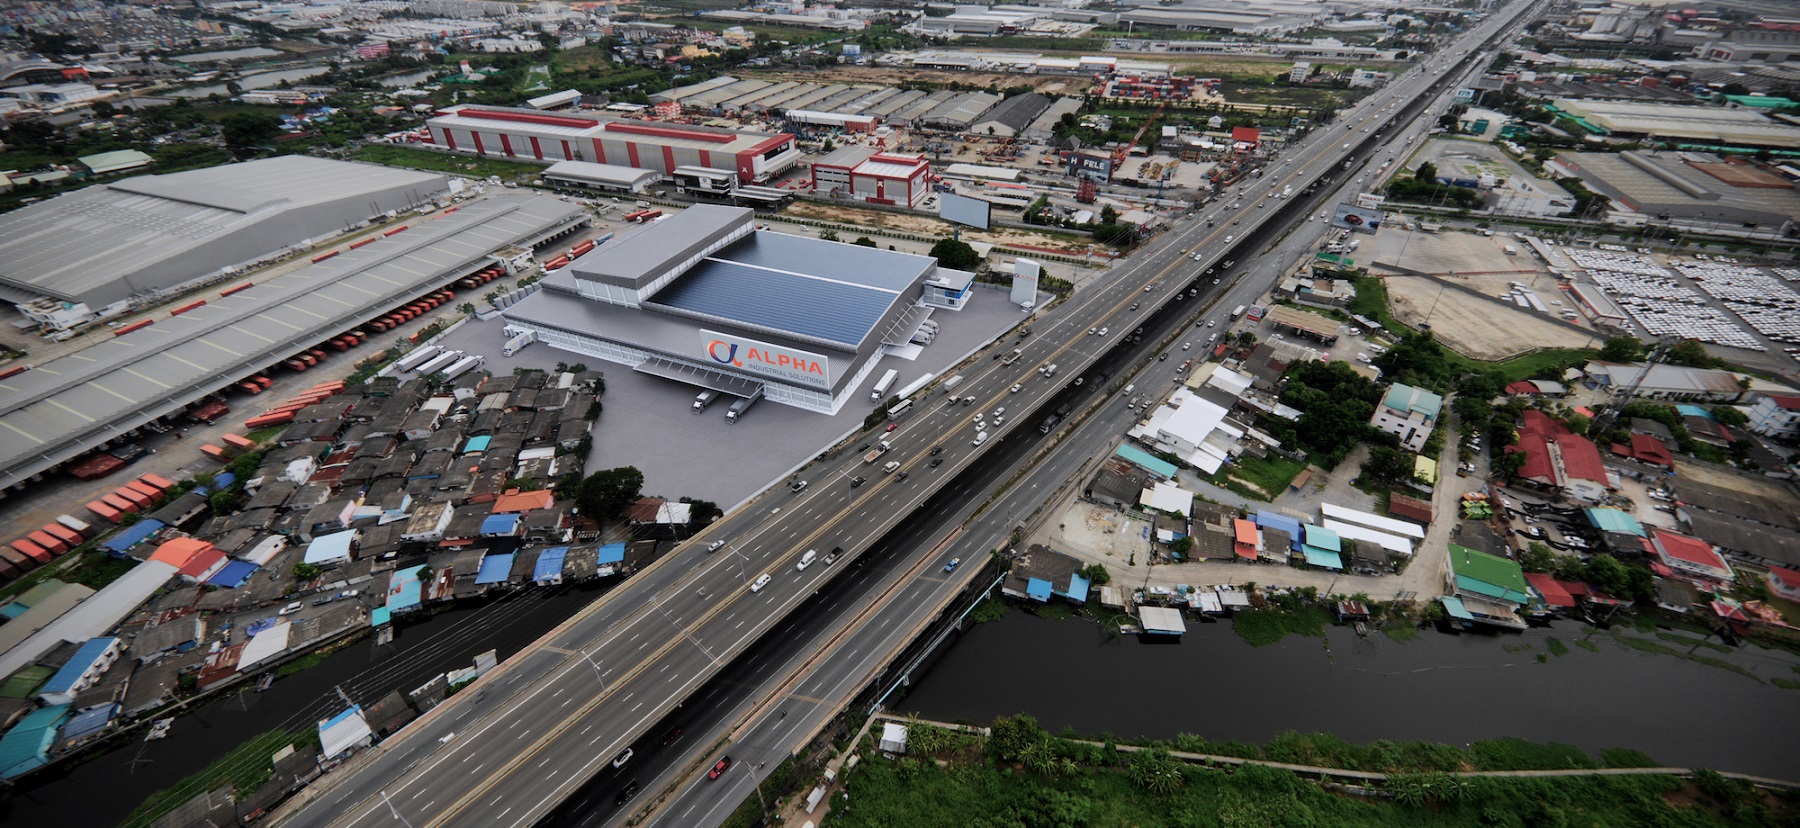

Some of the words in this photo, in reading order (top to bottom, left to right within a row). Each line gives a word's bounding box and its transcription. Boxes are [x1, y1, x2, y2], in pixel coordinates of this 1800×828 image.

[748, 348, 823, 375] ALPHA
[748, 363, 787, 377] INDUSTRIAL
[789, 372, 826, 385] SOLUTIONS
